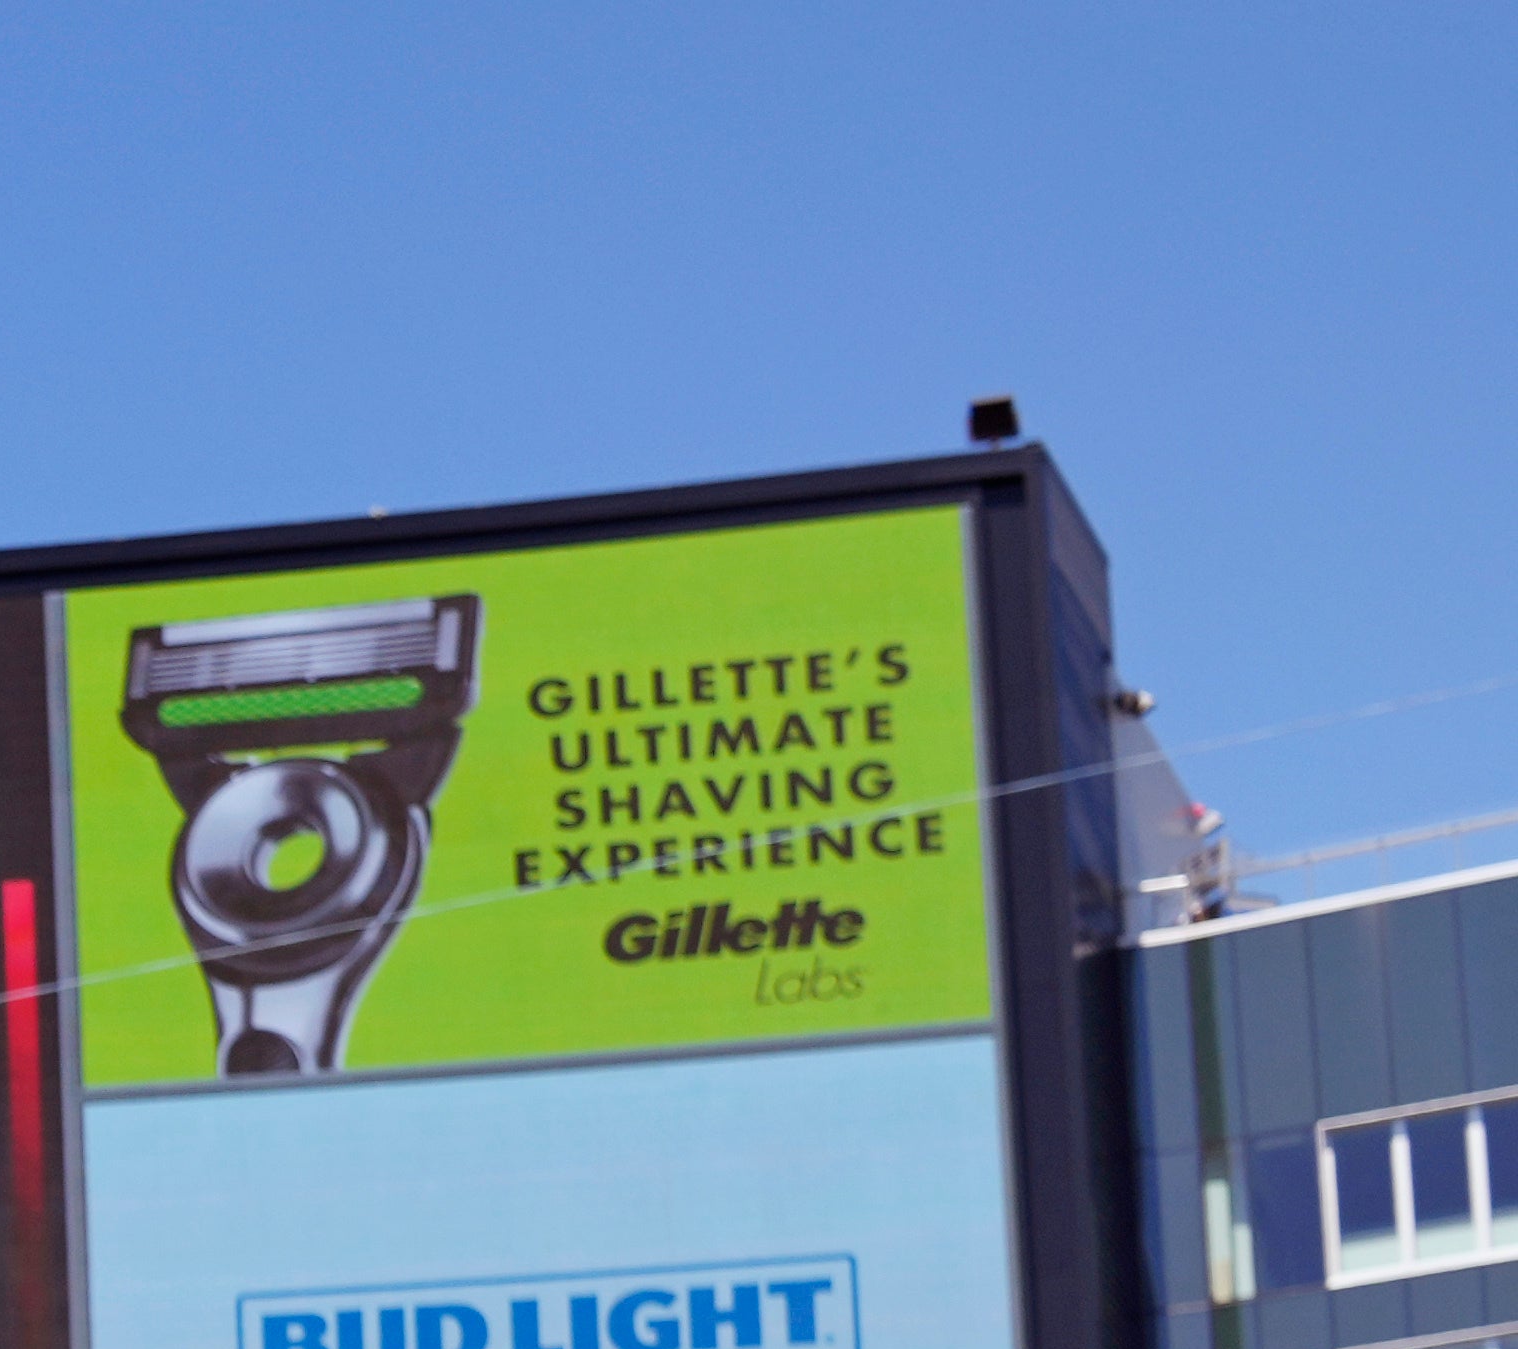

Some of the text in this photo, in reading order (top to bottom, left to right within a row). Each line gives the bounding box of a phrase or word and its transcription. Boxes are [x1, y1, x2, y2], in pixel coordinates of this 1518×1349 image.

[528, 643, 910, 719] GILLETTE'S
[551, 703, 894, 773] ULTIMATE
[555, 761, 894, 830] SHAVING
[514, 813, 945, 890] EXPERIENCE
[603, 897, 866, 964] Gillette
[755, 955, 865, 1006] Labs
